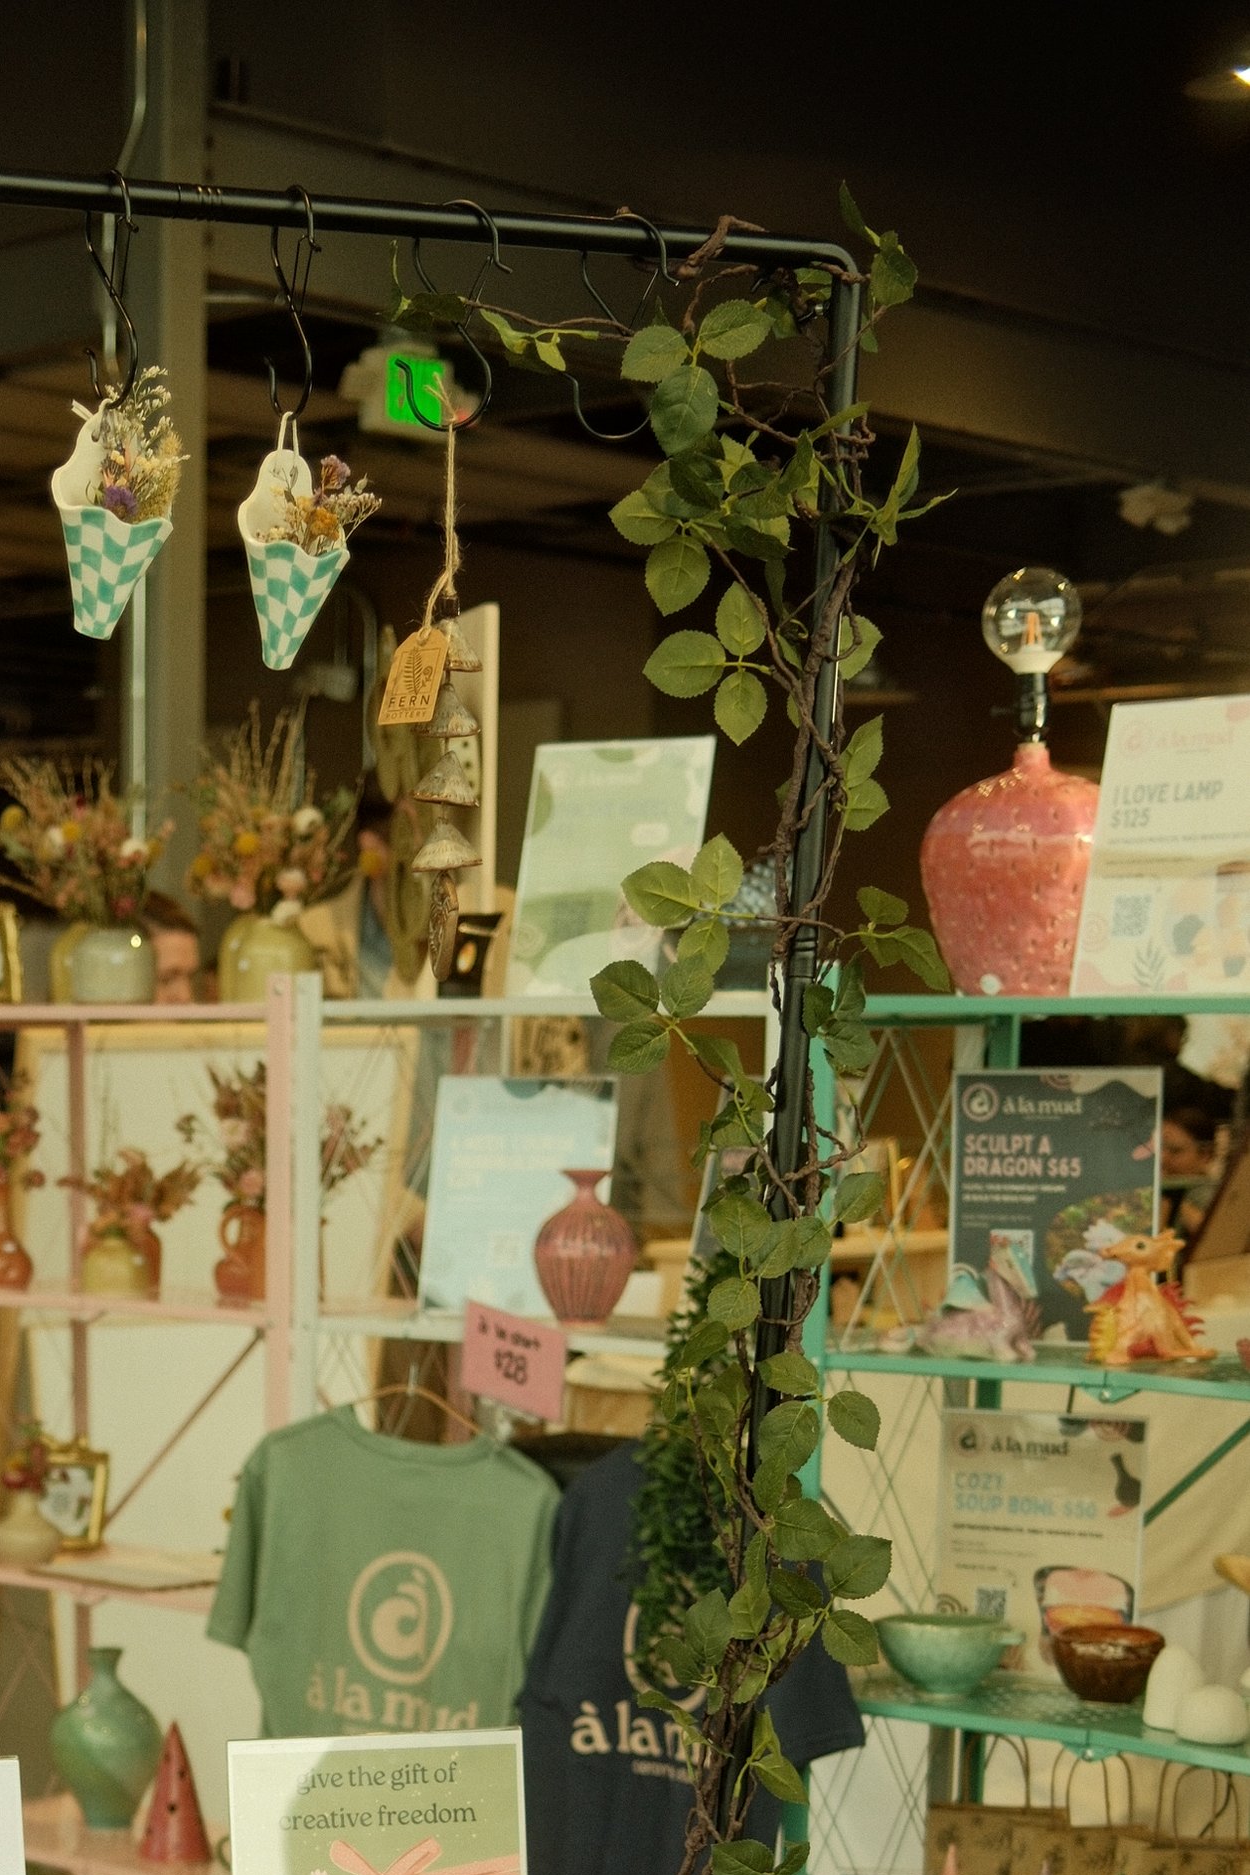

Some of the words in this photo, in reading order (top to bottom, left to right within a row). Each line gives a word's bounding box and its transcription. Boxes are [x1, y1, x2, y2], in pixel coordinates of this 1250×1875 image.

[388, 695, 431, 708] FERN
[386, 710, 428, 720] POTTERY
[1123, 783, 1169, 806] LOVE
[1174, 779, 1224, 803] LAMP
[1110, 807, 1152, 829] $125
[1038, 1098, 1083, 1116] mud
[964, 1134, 1034, 1154] SCULPT
[1038, 1135, 1051, 1154] A
[963, 1156, 1044, 1177] DRAGON
[1047, 1157, 1082, 1179] $65
[333, 1666, 373, 1722] la
[570, 1700, 612, 1755] à
[615, 1700, 662, 1758] la
[297, 1766, 344, 1796] give
[349, 1766, 386, 1787] the
[391, 1763, 429, 1791] gift
[433, 1761, 459, 1784] of
[278, 1807, 373, 1831] creative
[377, 1803, 477, 1827] freedom
